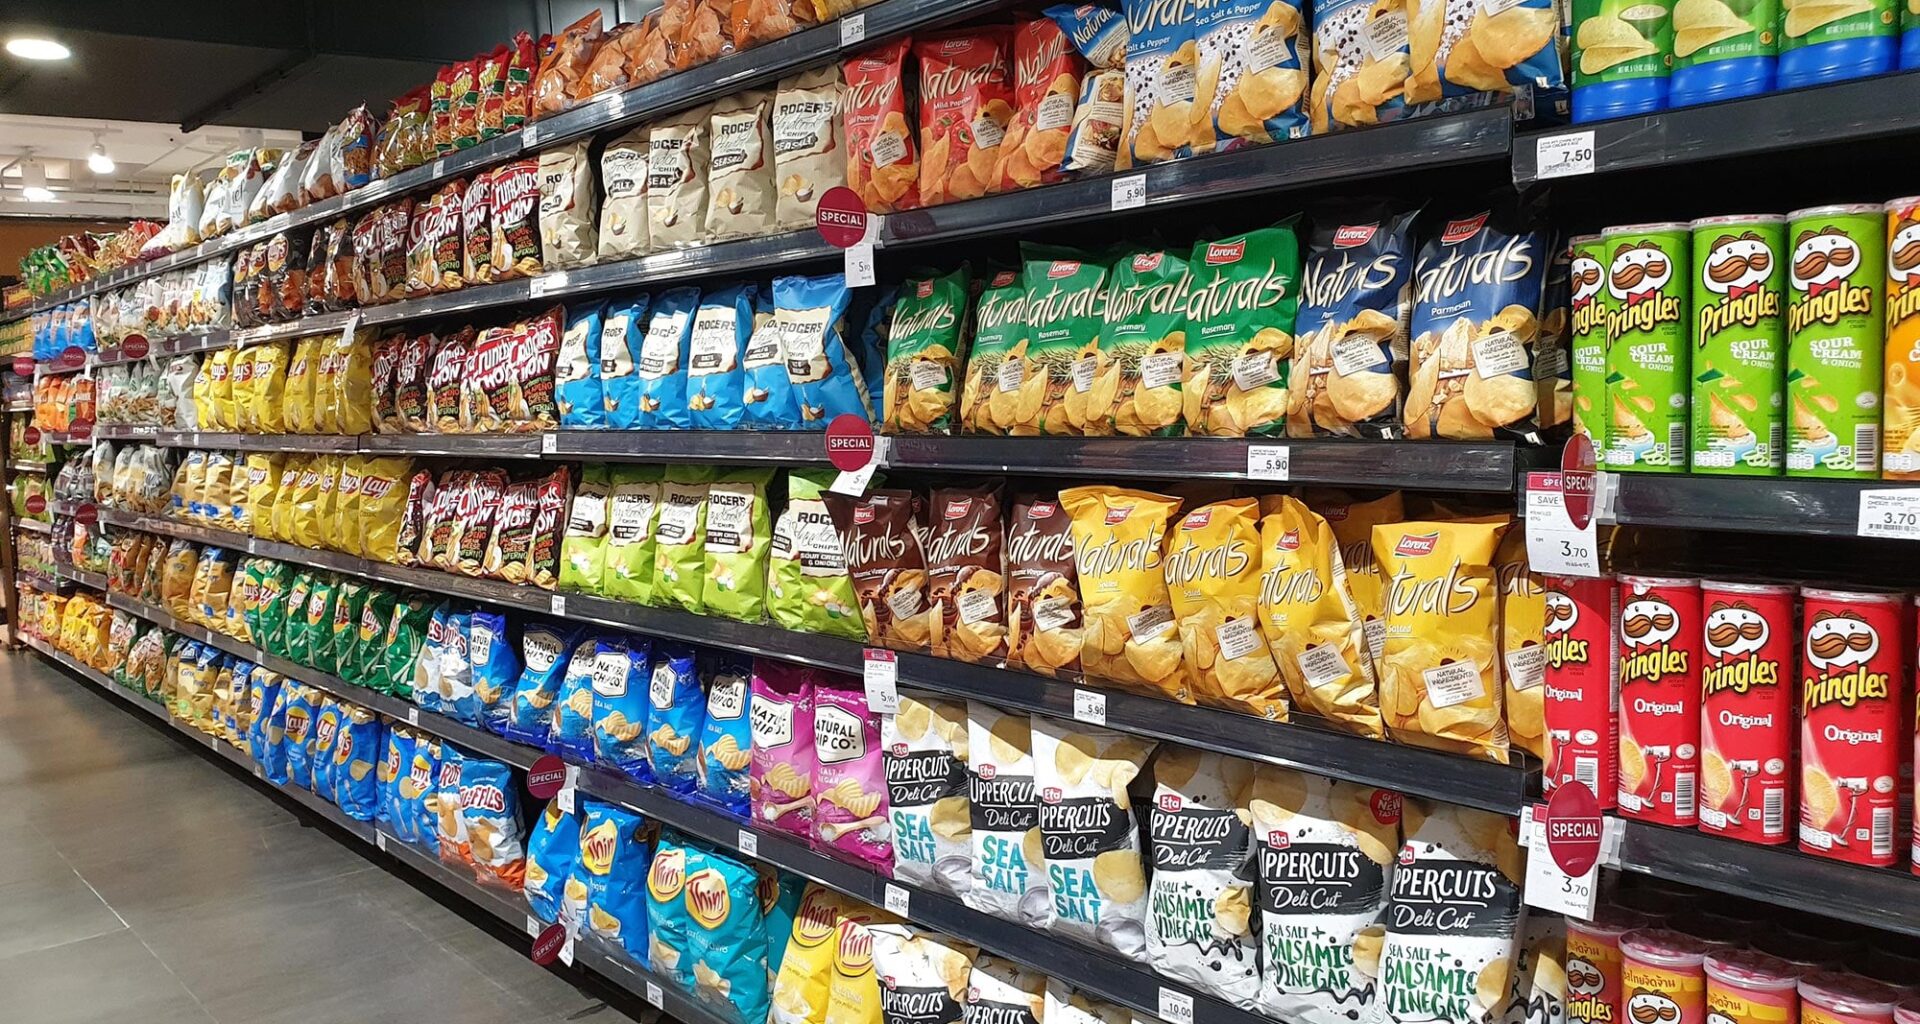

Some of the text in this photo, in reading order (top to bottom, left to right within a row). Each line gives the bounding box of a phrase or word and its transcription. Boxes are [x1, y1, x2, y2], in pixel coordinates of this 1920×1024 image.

[1235, 2, 1261, 15] Pepper
[1147, 36, 1171, 49] Pepper
[1562, 148, 1592, 163] 7.50
[1126, 187, 1144, 199] 5.90
[821, 211, 862, 225] SPECIAL
[1339, 230, 1368, 240] Lorenz
[1209, 246, 1239, 257] Lorenz
[1187, 257, 1292, 322] aturals
[1431, 299, 1472, 316] Parmesan
[1699, 284, 1779, 348] Pringles
[1788, 280, 1872, 346] Pringles
[1886, 284, 1920, 337] Prin
[1202, 323, 1236, 334] Rosemary
[1606, 290, 1680, 351] Pringles
[1038, 329, 1070, 339] Rosemary
[1629, 343, 1668, 357] SOUR
[1730, 339, 1769, 352] SOUR
[1810, 337, 1855, 352] SOUR
[1631, 354, 1675, 364] CREAM
[1733, 350, 1775, 361] CREAM
[1812, 349, 1863, 360] CREAM
[1832, 359, 1862, 369] ONION
[830, 438, 870, 448] SPECIAL
[1266, 460, 1288, 471] 5.90
[1537, 496, 1559, 505] SAVE
[1884, 512, 1917, 525] 3.70
[813, 543, 839, 551] CHIPS
[1400, 539, 1432, 550] Lorenz
[1560, 540, 1588, 558] 3.70
[1164, 526, 1249, 587] aturals
[1387, 556, 1480, 622] turals
[1546, 633, 1588, 669] ngles
[1436, 667, 1466, 679] NATURAL
[1619, 644, 1688, 692] Pringles
[1702, 654, 1779, 704] Pringles
[1545, 684, 1583, 702] Original
[1803, 666, 1889, 719] Pringles
[1088, 704, 1105, 716] 5.90
[1634, 698, 1683, 716] Original
[1719, 710, 1773, 729] Original
[1824, 724, 1883, 745] Original
[893, 744, 908, 755] Eta
[531, 772, 563, 784] SPECIAL
[980, 765, 994, 778] Eta
[892, 785, 941, 801] Deli Cut
[1044, 788, 1062, 802] Eta
[1163, 795, 1180, 810] Eta
[893, 811, 935, 842] SEA
[985, 809, 1032, 827] Deli Cut
[1552, 822, 1599, 838] SPECIAL
[583, 830, 614, 864] Thin
[1046, 836, 1100, 855] Deli Cut
[1269, 831, 1290, 848] Eta
[899, 838, 937, 864] SALT
[982, 834, 1028, 871] SEA
[1154, 845, 1212, 866] Deli Cut
[654, 851, 684, 888] Thins
[981, 864, 1029, 895] SALT
[1049, 863, 1100, 899] SEA
[1562, 875, 1589, 897] 3.70
[686, 871, 726, 916] Thins
[1270, 886, 1343, 909] Deli Cut
[800, 887, 839, 935] Thins
[1055, 894, 1102, 926] SALT
[1152, 889, 1216, 921] BALSAMIC
[1394, 904, 1476, 930] Deli Cut
[1153, 913, 1214, 940] VINEGAR
[1269, 922, 1284, 937] SEA
[1286, 925, 1309, 939] SALT
[535, 932, 564, 958] SPECIAL
[837, 915, 874, 963] Thin
[1267, 935, 1354, 969] BALSAMIC
[1389, 943, 1404, 958] SEA
[1406, 946, 1430, 960] SALT
[1271, 960, 1351, 990] VINEGAR
[1384, 956, 1479, 995] BALSAMIC
[1384, 984, 1472, 1018] VINEGAR
[1169, 1003, 1192, 1018] 10.00
